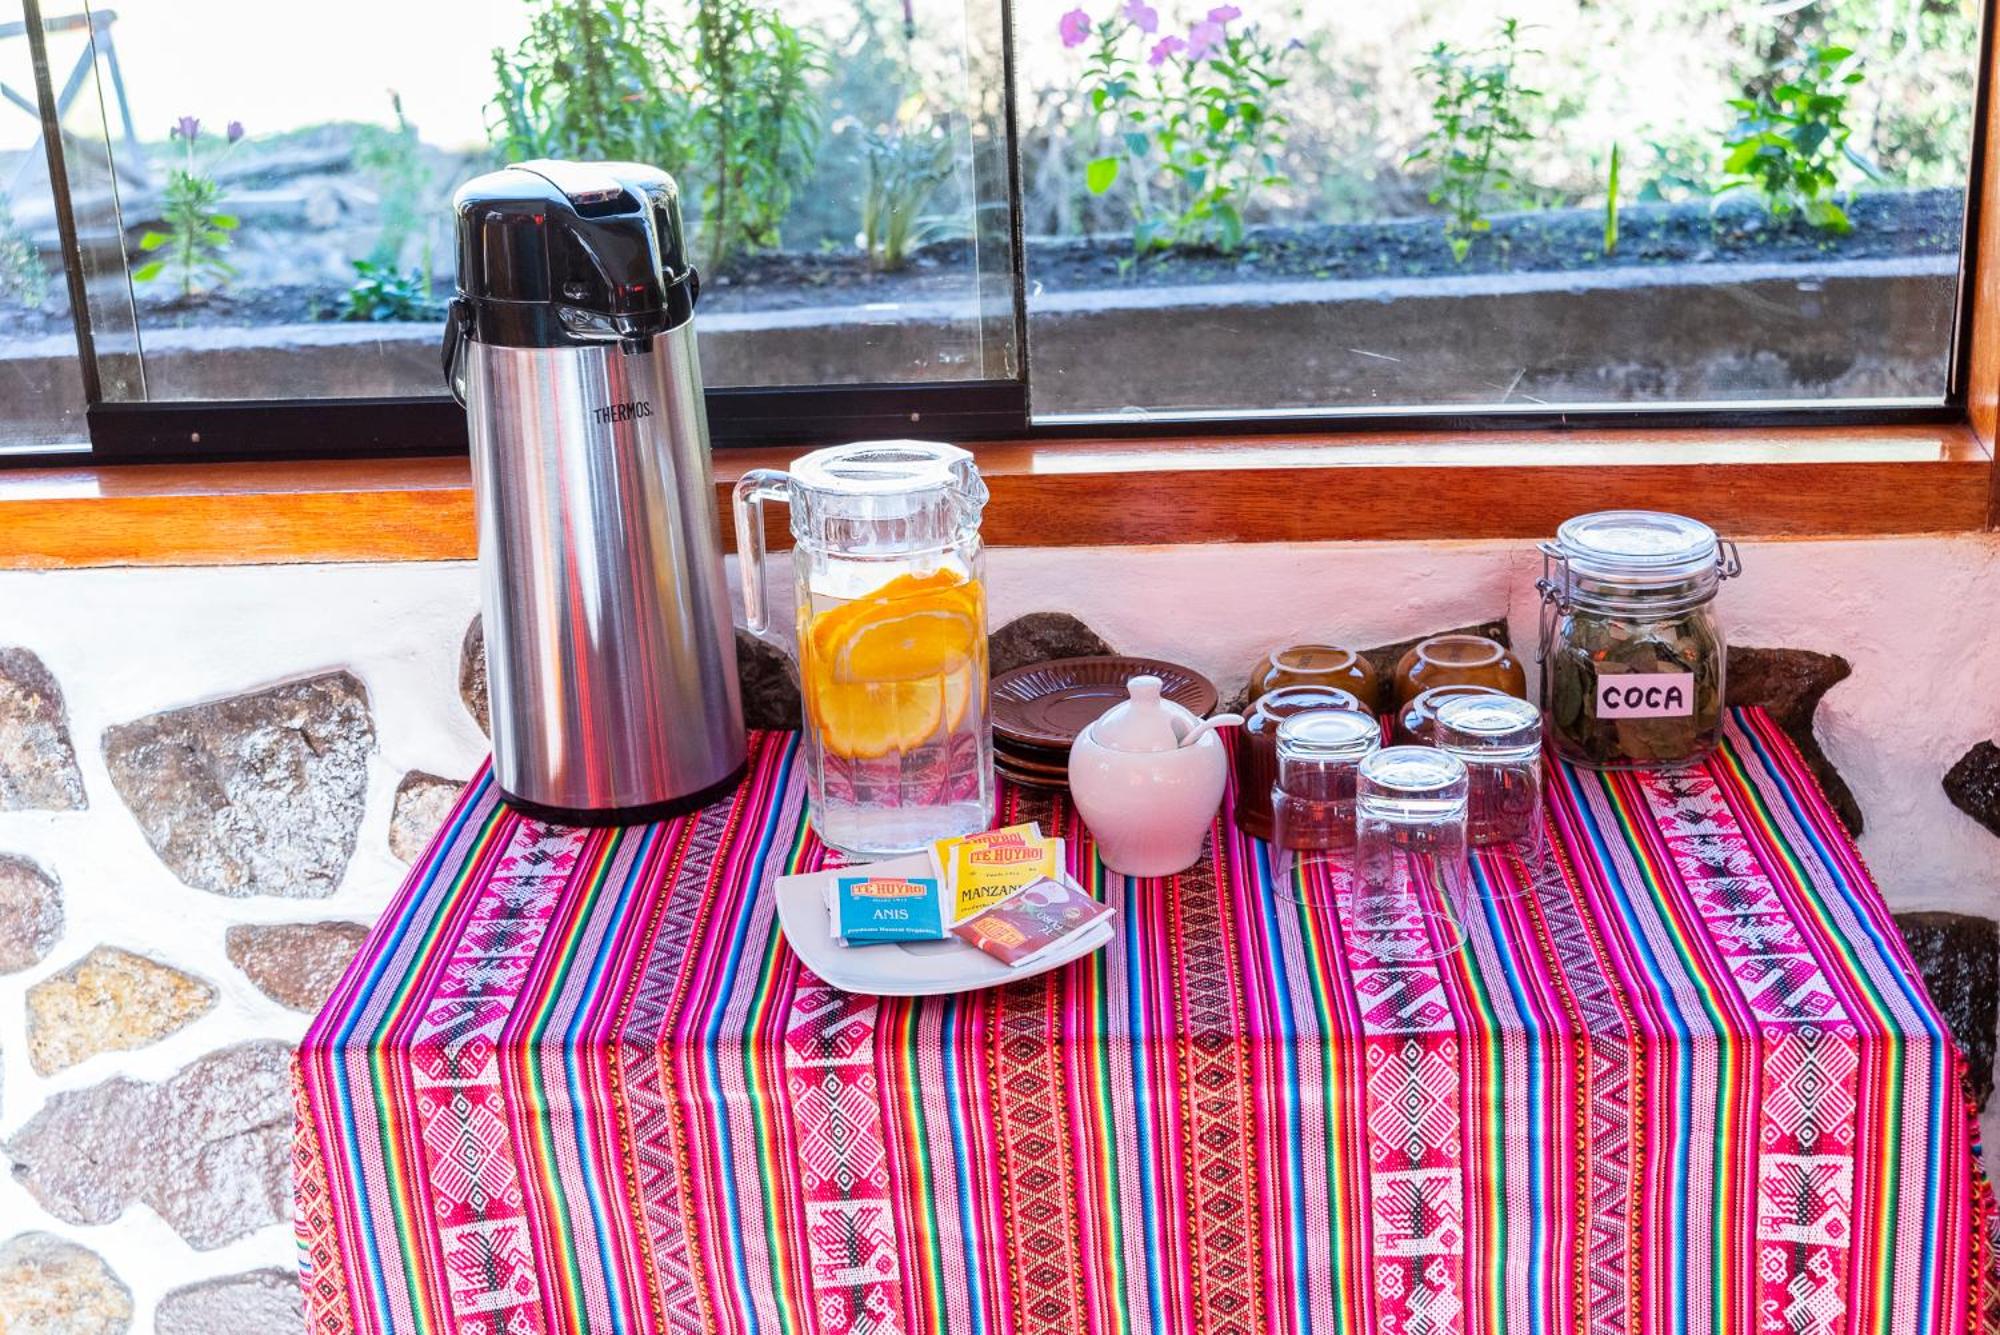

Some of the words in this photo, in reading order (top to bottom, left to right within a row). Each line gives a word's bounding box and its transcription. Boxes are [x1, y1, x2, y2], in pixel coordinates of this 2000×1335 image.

[593, 401, 651, 424] THERMOS
[1602, 686, 1684, 710] COCA
[962, 884, 1022, 902] MANZAN
[873, 908, 909, 920] ANIS
